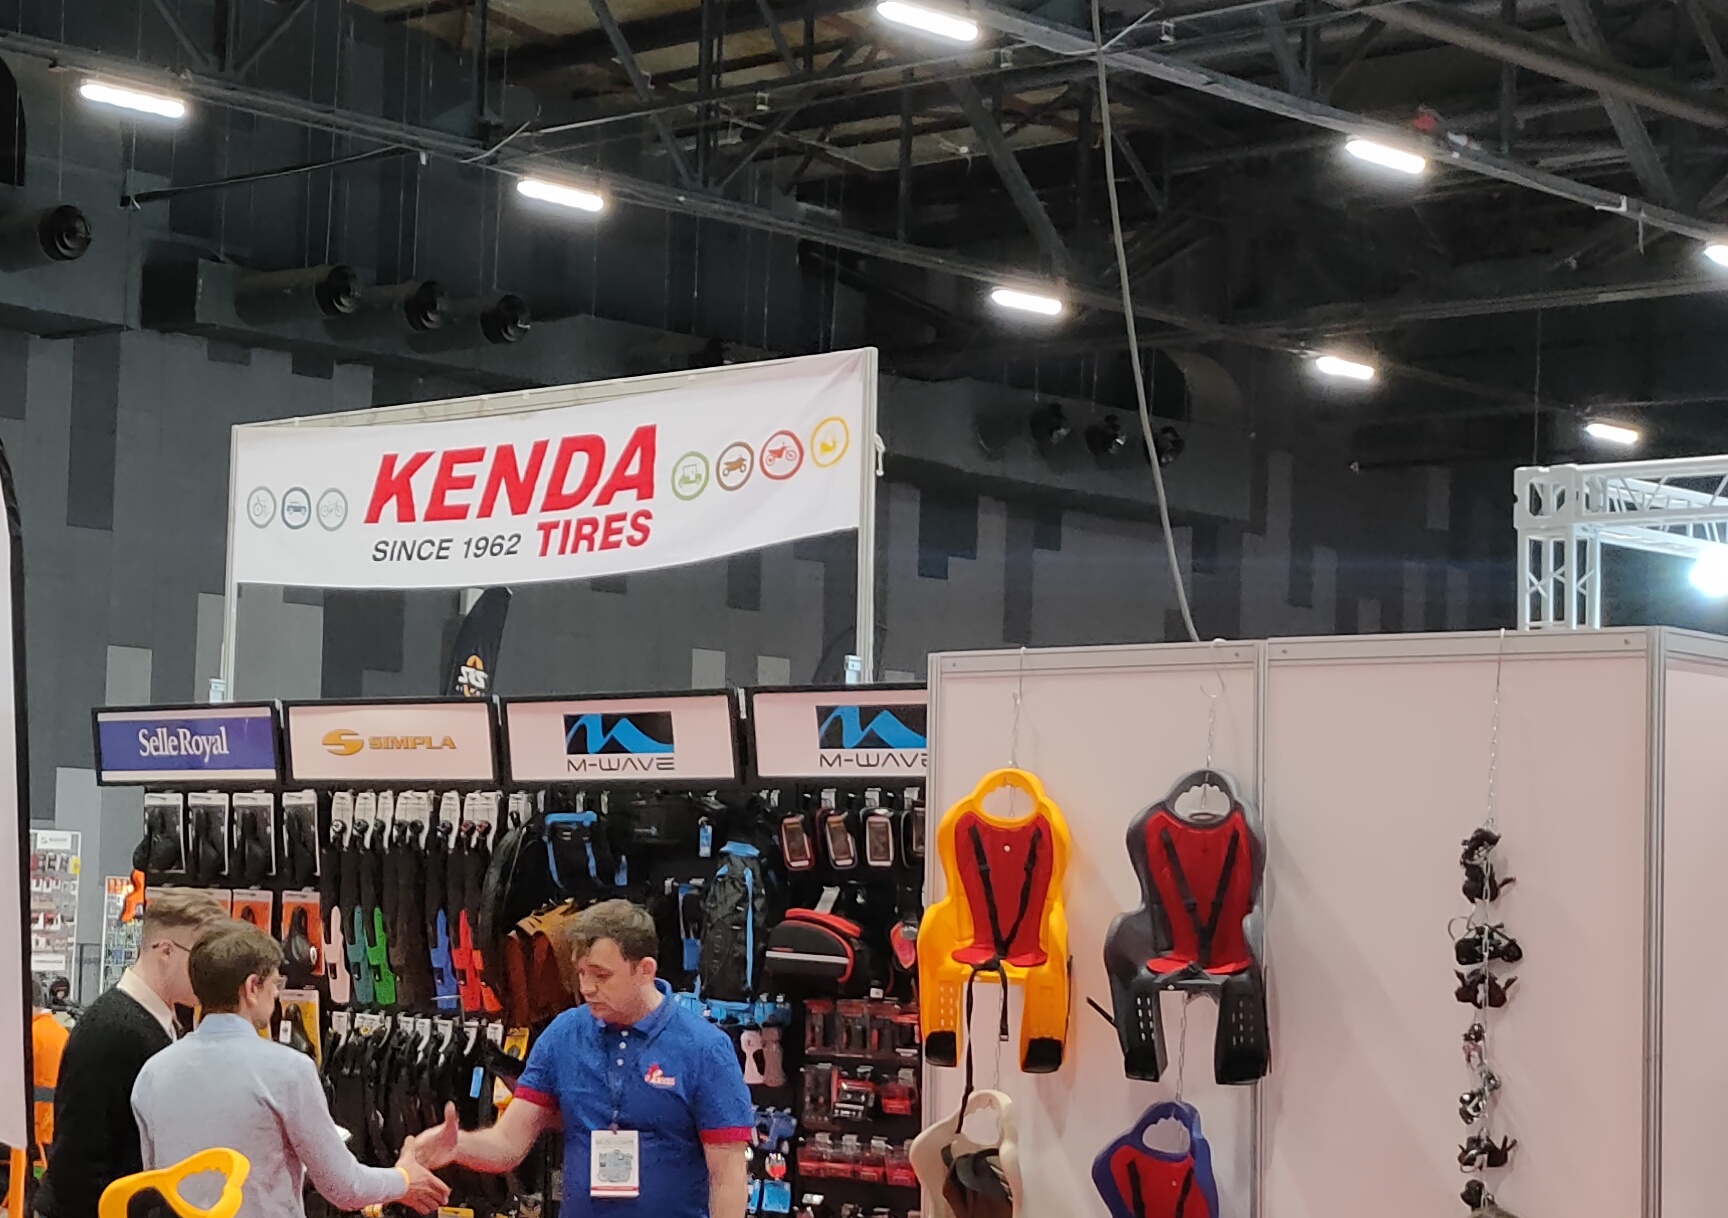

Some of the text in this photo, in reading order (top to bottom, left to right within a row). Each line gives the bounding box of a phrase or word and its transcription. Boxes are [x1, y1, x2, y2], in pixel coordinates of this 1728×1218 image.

[364, 423, 657, 525] KENDA
[371, 533, 522, 562] SINCE 1962
[535, 508, 655, 558] TIRES
[368, 735, 457, 750] SIMPLA
[566, 756, 676, 772] M-WAVE
